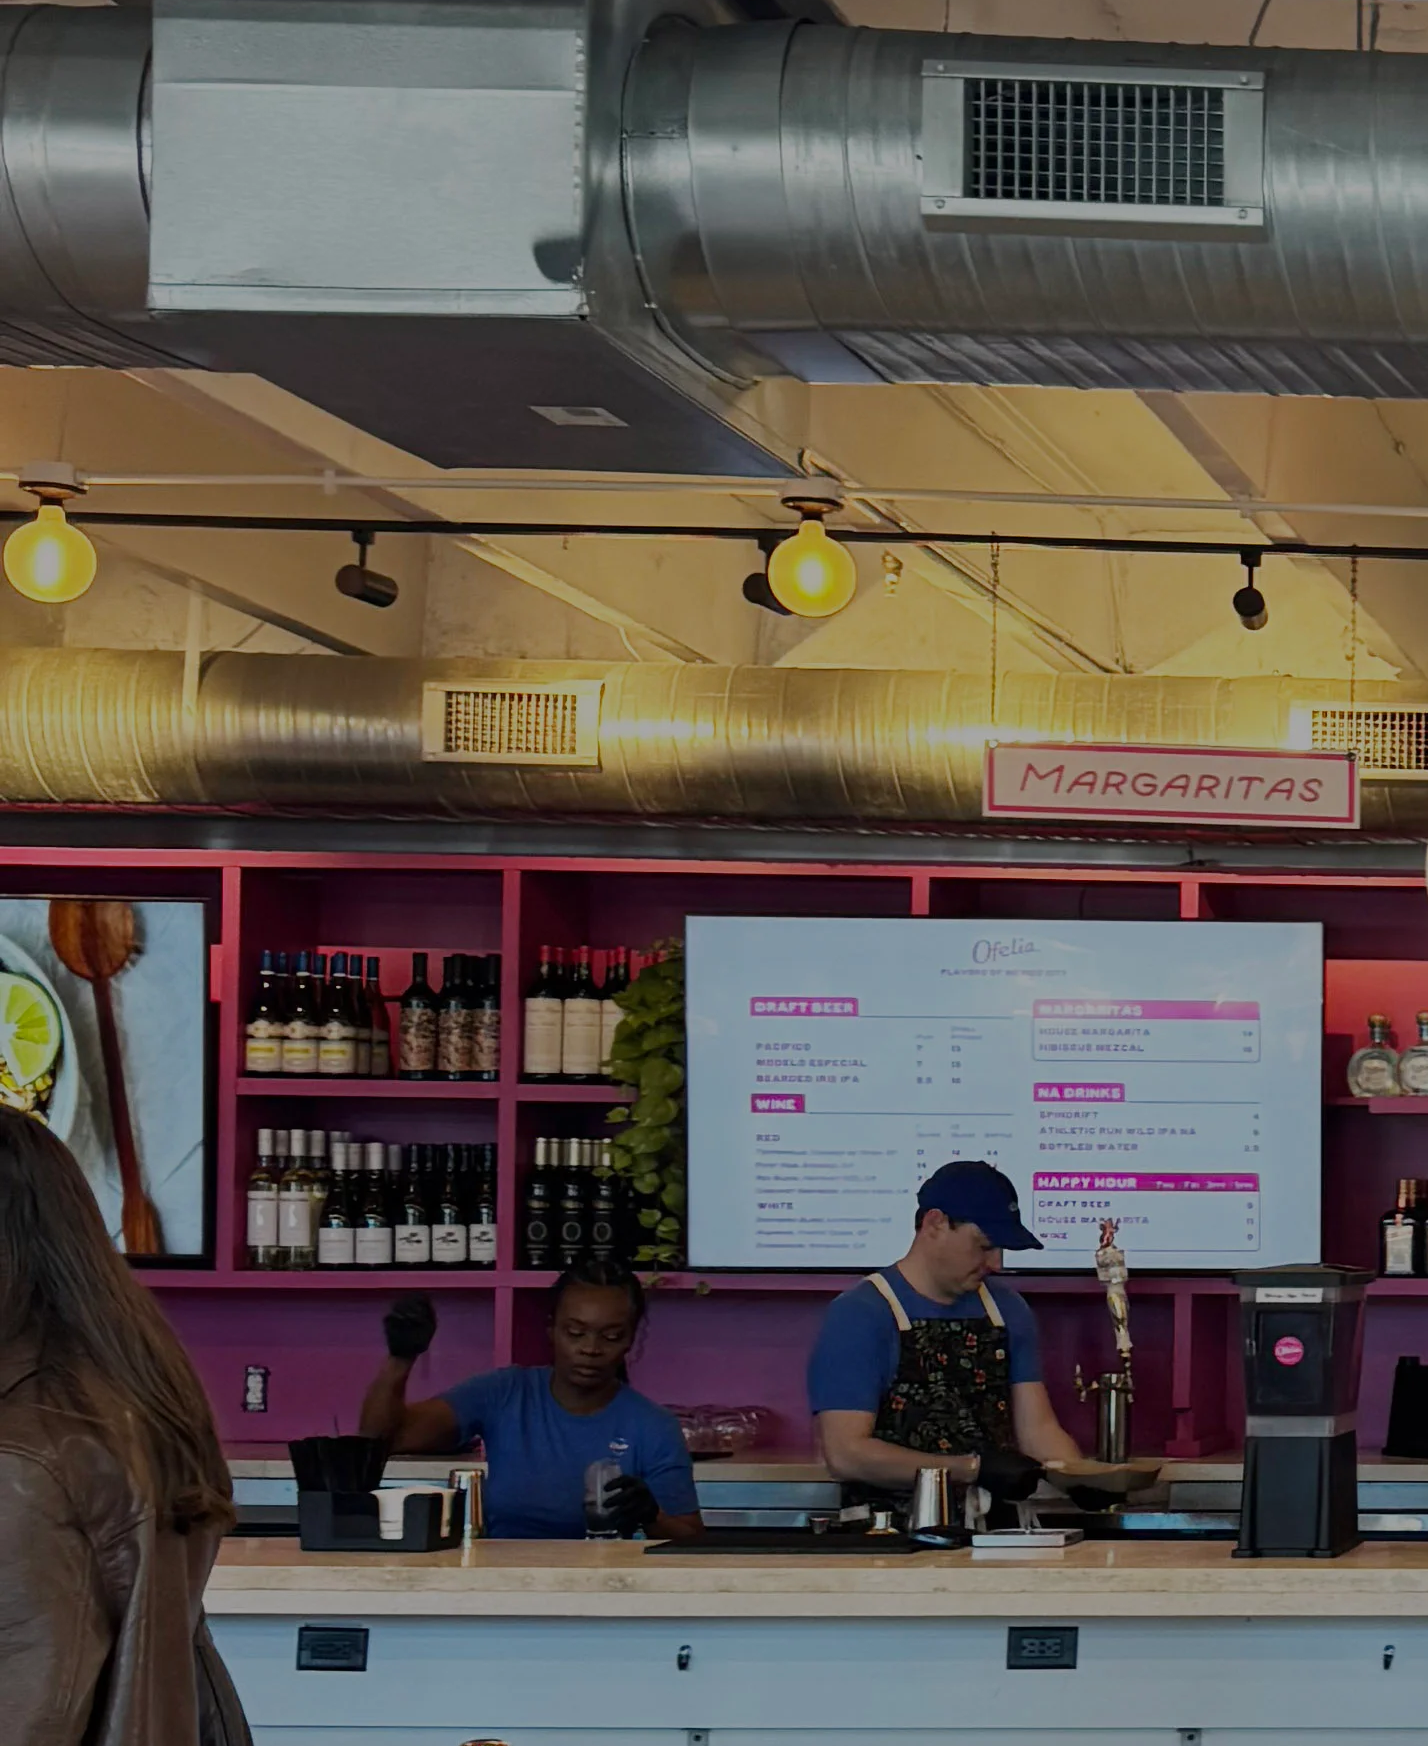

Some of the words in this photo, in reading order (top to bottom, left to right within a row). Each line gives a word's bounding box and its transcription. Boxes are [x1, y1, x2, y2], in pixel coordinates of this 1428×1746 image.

[1020, 763, 1323, 802] MARGARITAS
[972, 937, 1041, 964] Ofelia
[754, 1001, 808, 1013] DRAFT
[812, 1002, 855, 1013] BEER
[1038, 1005, 1143, 1017] MARGARITAS
[1096, 1044, 1145, 1052] MEZCAL
[756, 1058, 806, 1067] MODELO
[809, 1059, 867, 1067] ESPECIAL
[756, 1075, 812, 1084] BEARDED
[1037, 1087, 1060, 1099] NA
[1064, 1087, 1121, 1099] DRINKS
[755, 1098, 796, 1110] WINE
[756, 1134, 780, 1142] RED
[1039, 1142, 1092, 1151] BOTTLED
[1097, 1143, 1138, 1151] WATER
[1038, 1177, 1090, 1189] HAPPY
[1095, 1178, 1137, 1189] HOUR
[757, 1202, 793, 1210] WHITE
